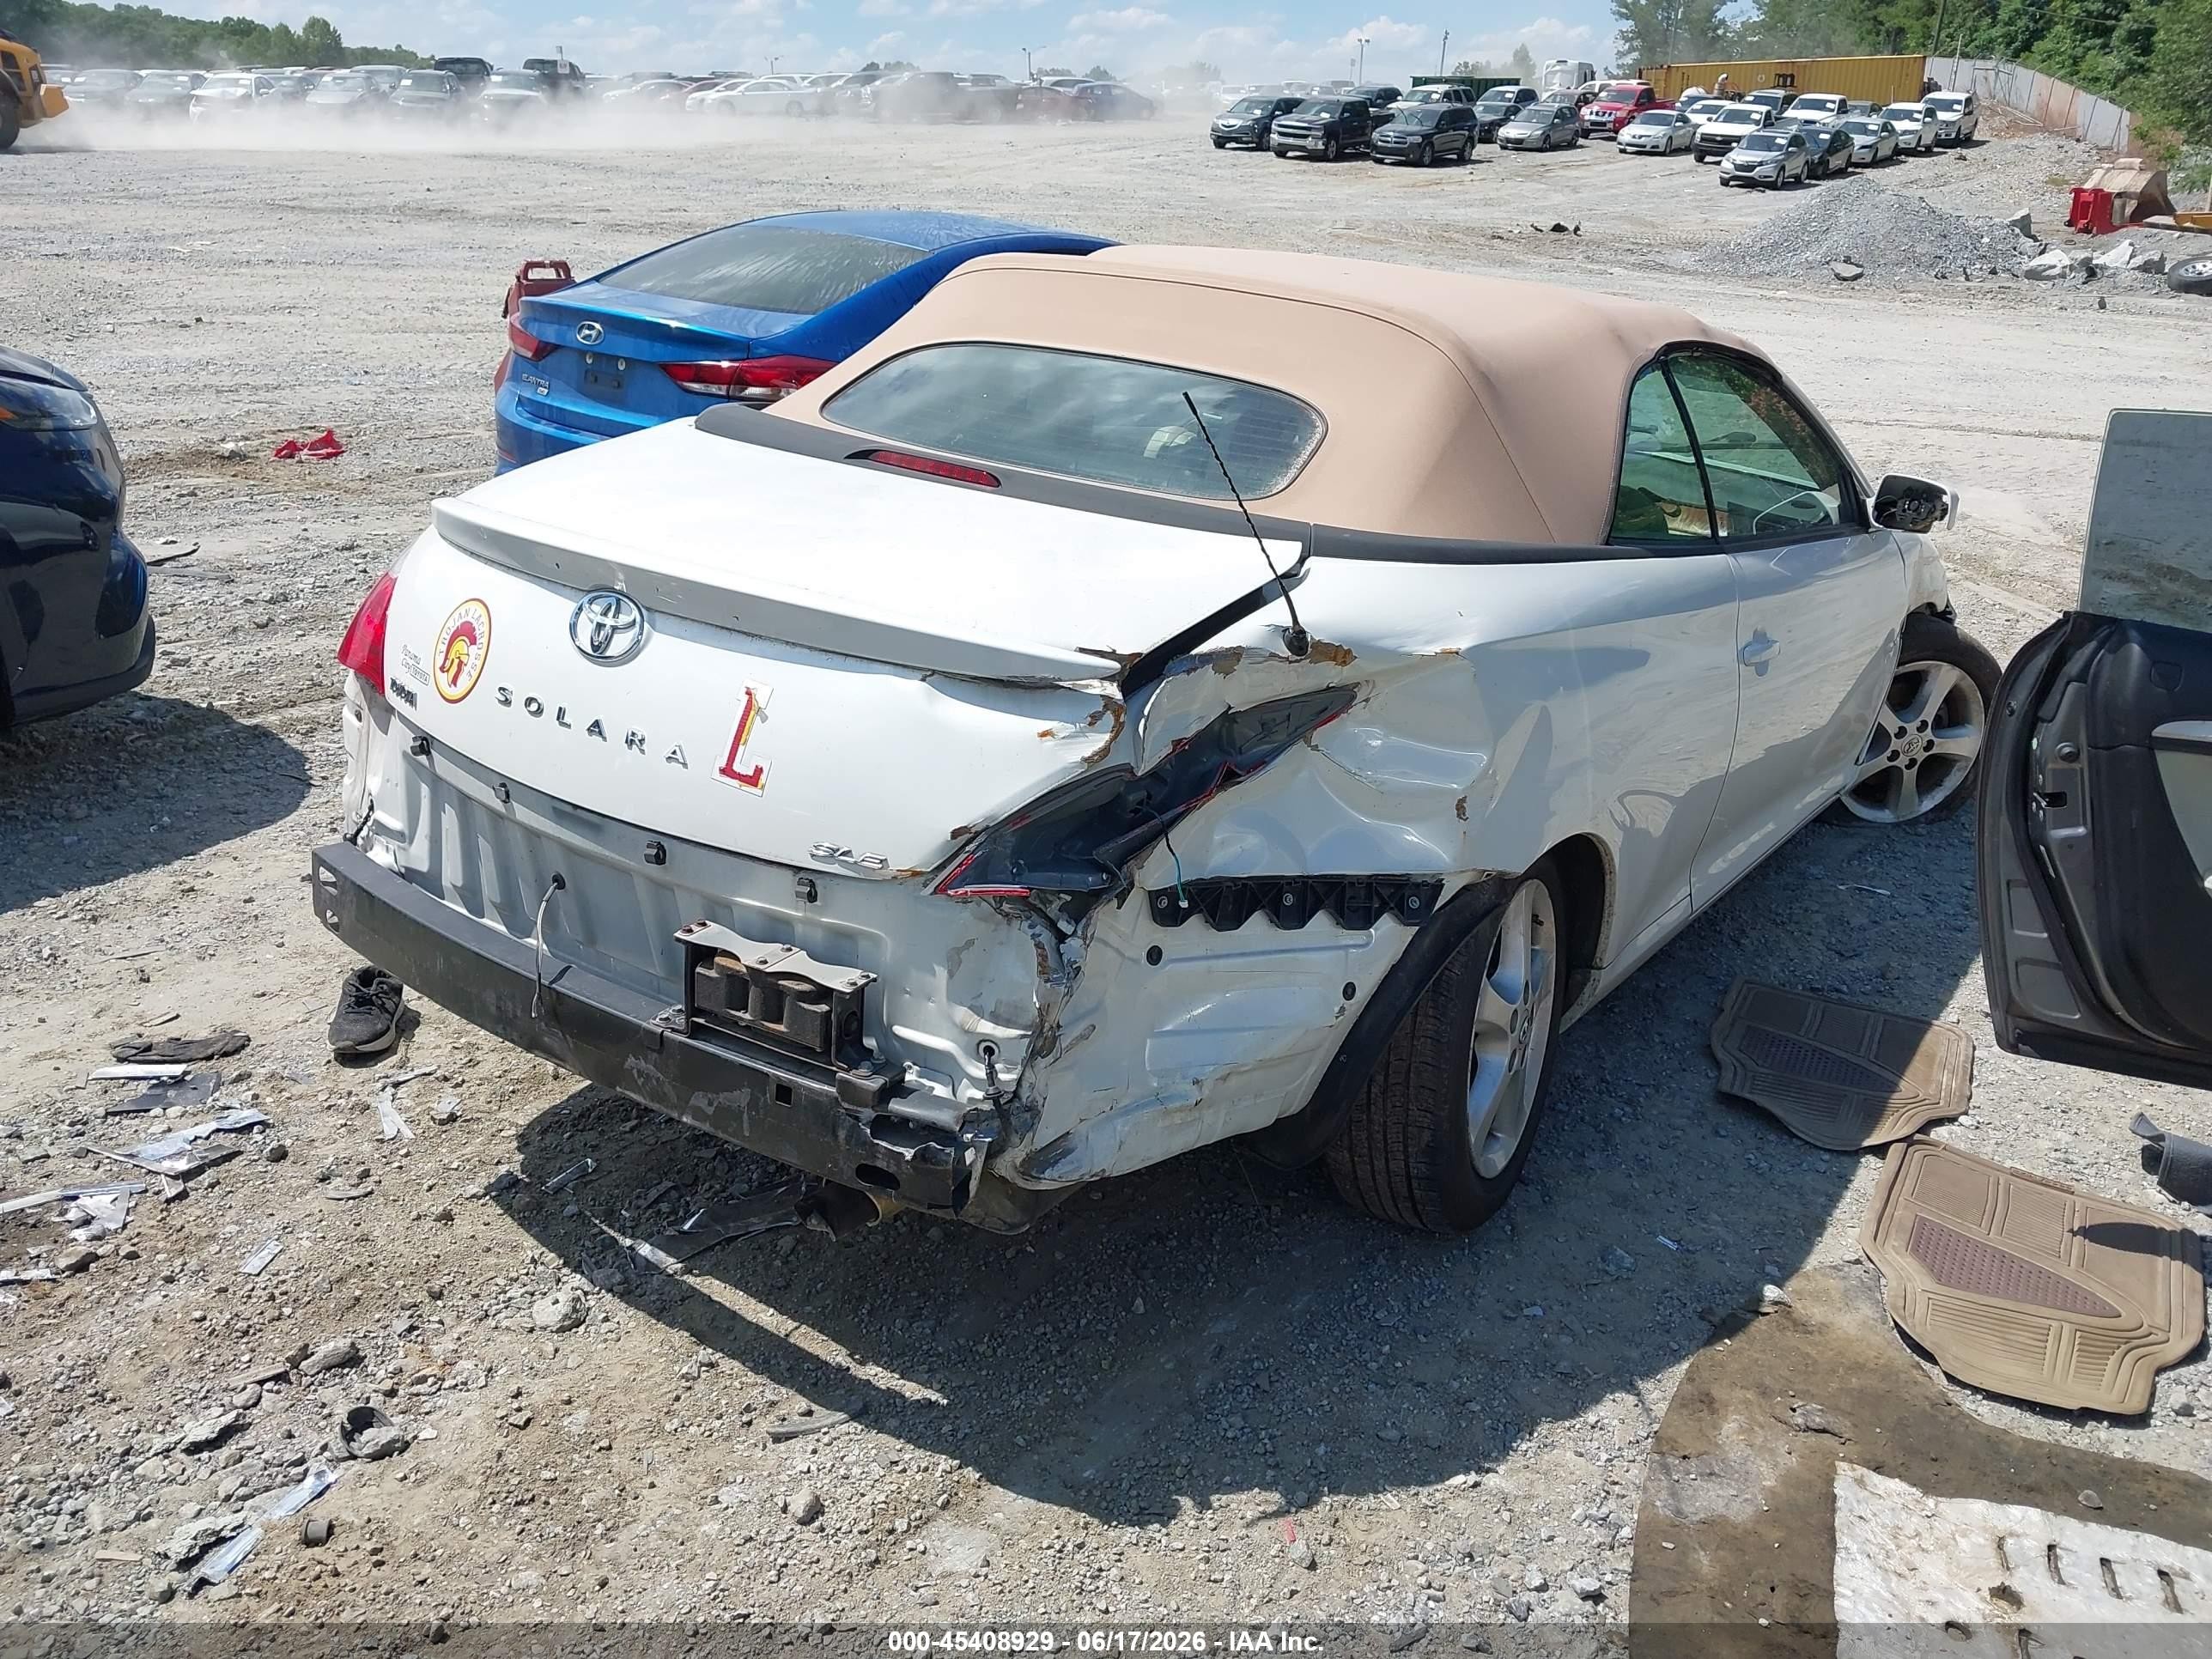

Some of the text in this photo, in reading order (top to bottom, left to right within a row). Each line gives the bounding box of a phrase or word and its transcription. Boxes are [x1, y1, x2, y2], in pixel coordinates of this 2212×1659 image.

[522, 374, 550, 389] ELANTRA
[438, 607, 485, 683] TROJAN LACROSSE
[412, 666, 428, 684] TOYOTA
[495, 686, 689, 770] SOLARA
[807, 842, 890, 872] SLE
